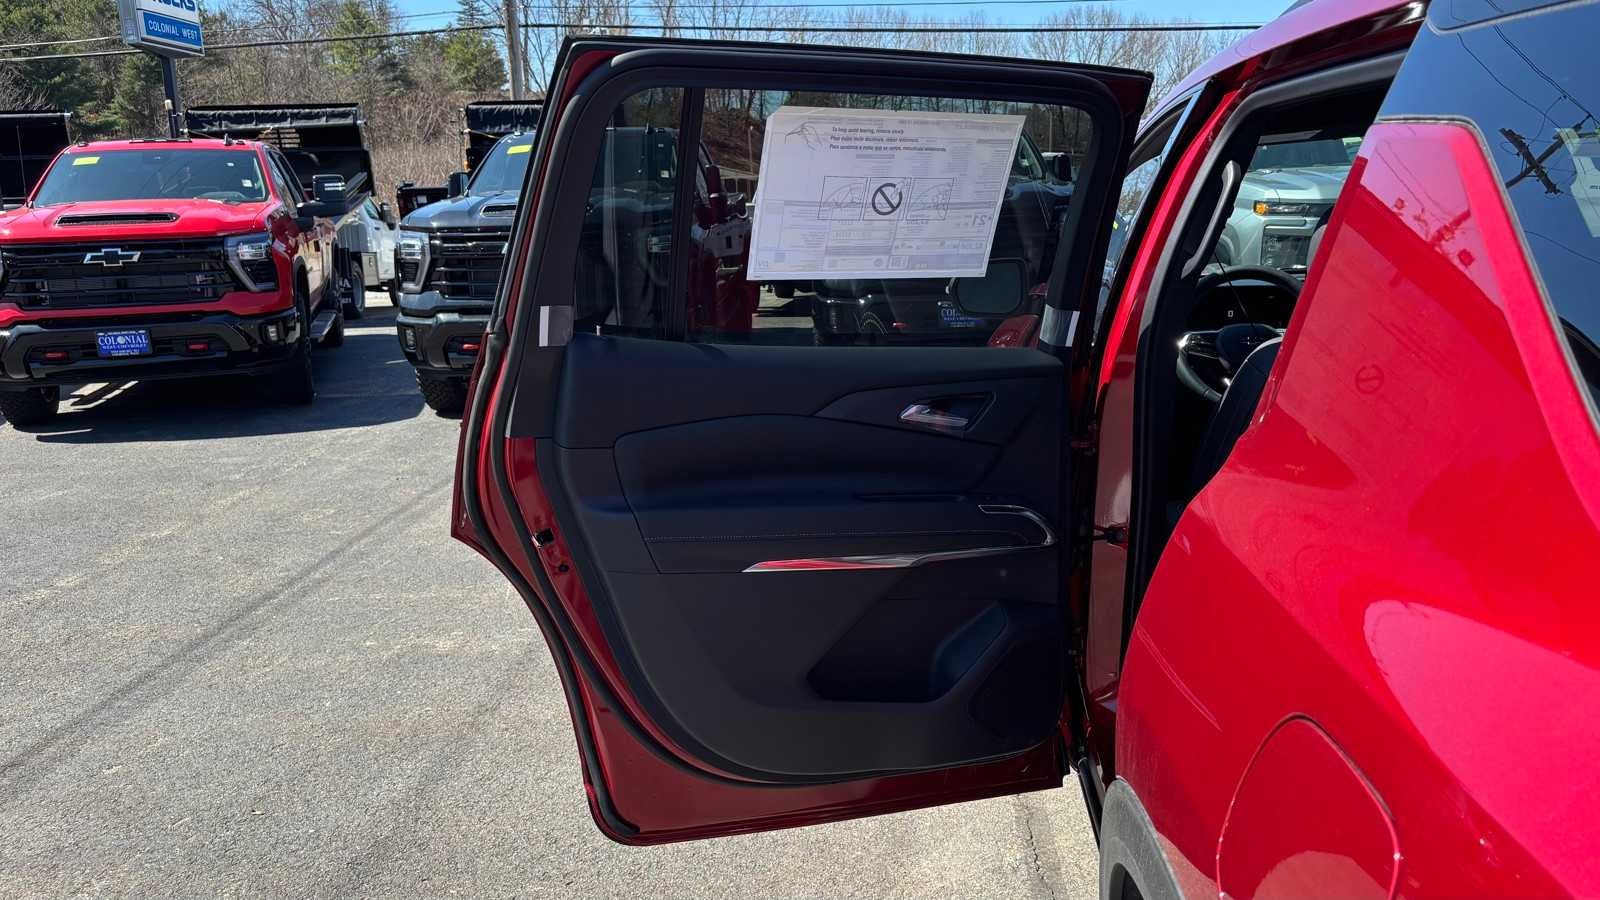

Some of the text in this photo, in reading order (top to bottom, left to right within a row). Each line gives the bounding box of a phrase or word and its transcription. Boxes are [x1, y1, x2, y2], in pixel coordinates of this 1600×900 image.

[148, 20, 198, 41] COLONIAL WEST
[98, 334, 149, 346] COLONIAL
